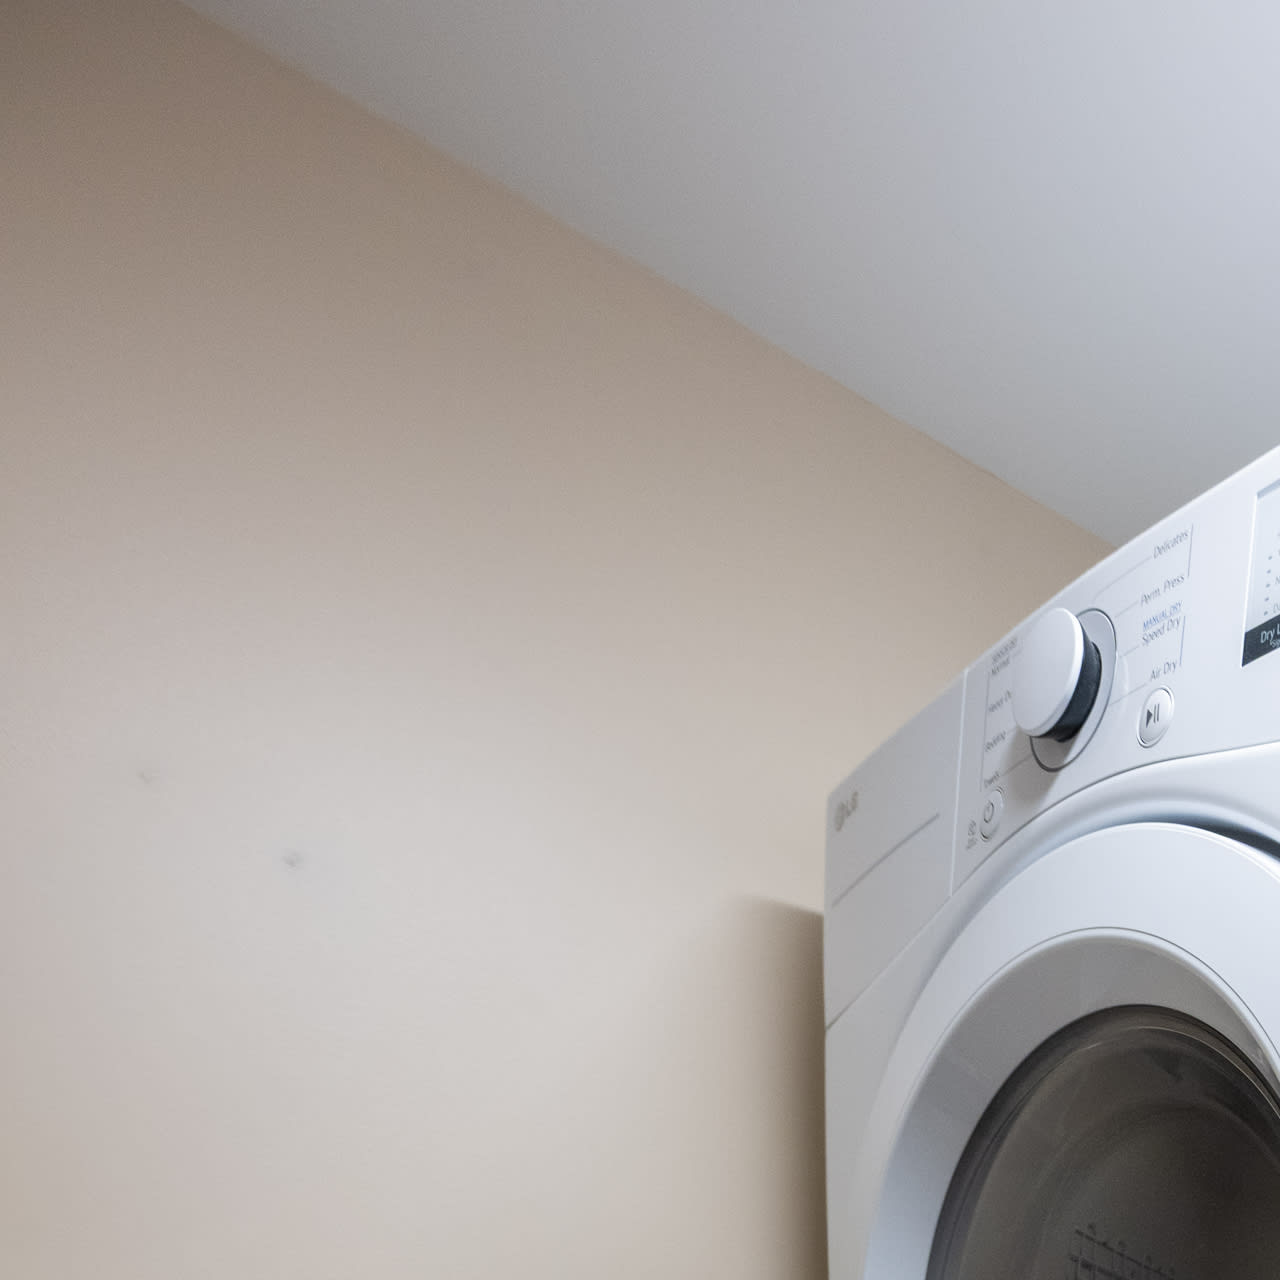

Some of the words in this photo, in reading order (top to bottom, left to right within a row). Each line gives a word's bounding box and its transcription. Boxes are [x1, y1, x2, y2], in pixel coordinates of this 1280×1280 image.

[1153, 529, 1188, 560] Delicates
[1163, 574, 1185, 593] Press
[1142, 609, 1169, 633] MANUAL
[1170, 599, 1183, 617] DRY
[1141, 623, 1165, 646] Speed
[1166, 616, 1181, 633] Dry
[1260, 624, 1275, 644] Dry
[1150, 666, 1162, 682] Air
[1163, 659, 1177, 676] Dry
